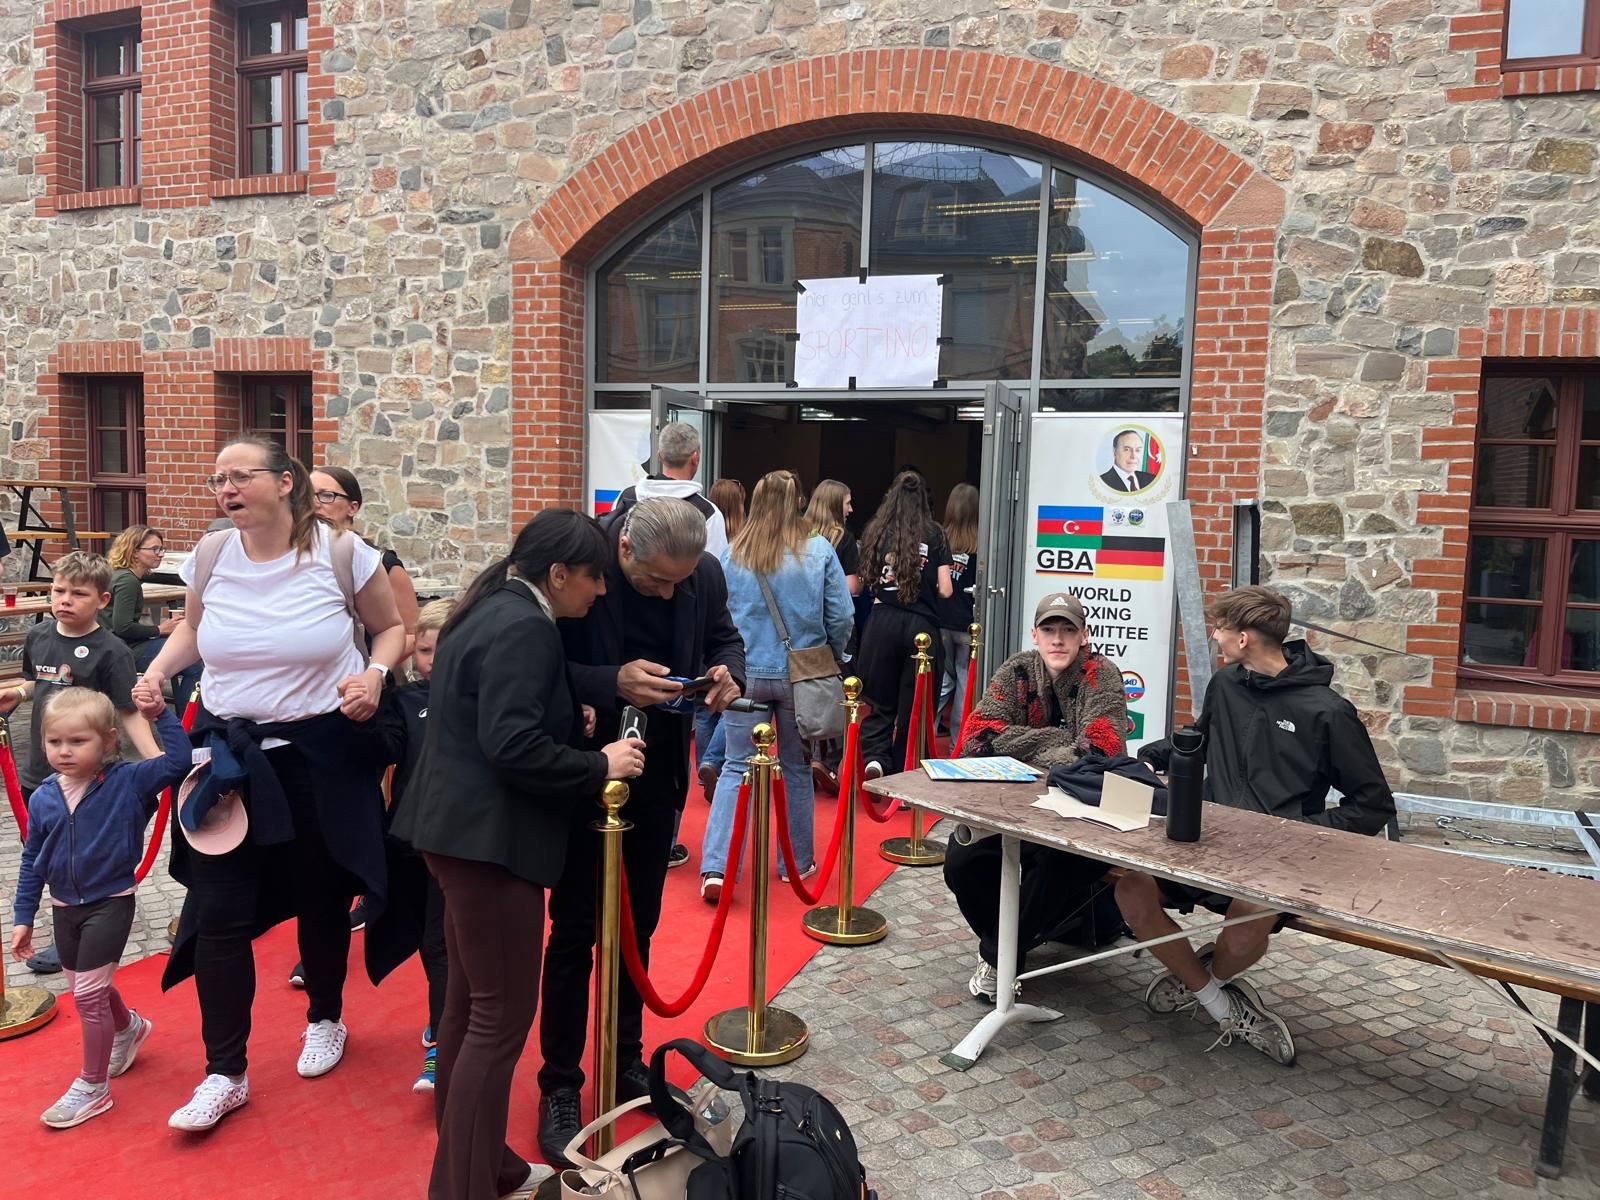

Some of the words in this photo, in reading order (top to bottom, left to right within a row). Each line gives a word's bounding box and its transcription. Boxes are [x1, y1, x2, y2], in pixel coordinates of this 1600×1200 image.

[797, 325, 929, 360] SPORTINO
[1036, 549, 1094, 571] GBA
[1068, 586, 1132, 603] WORLD
[1082, 605, 1132, 621] OXING
[1087, 624, 1149, 640] MITTEE
